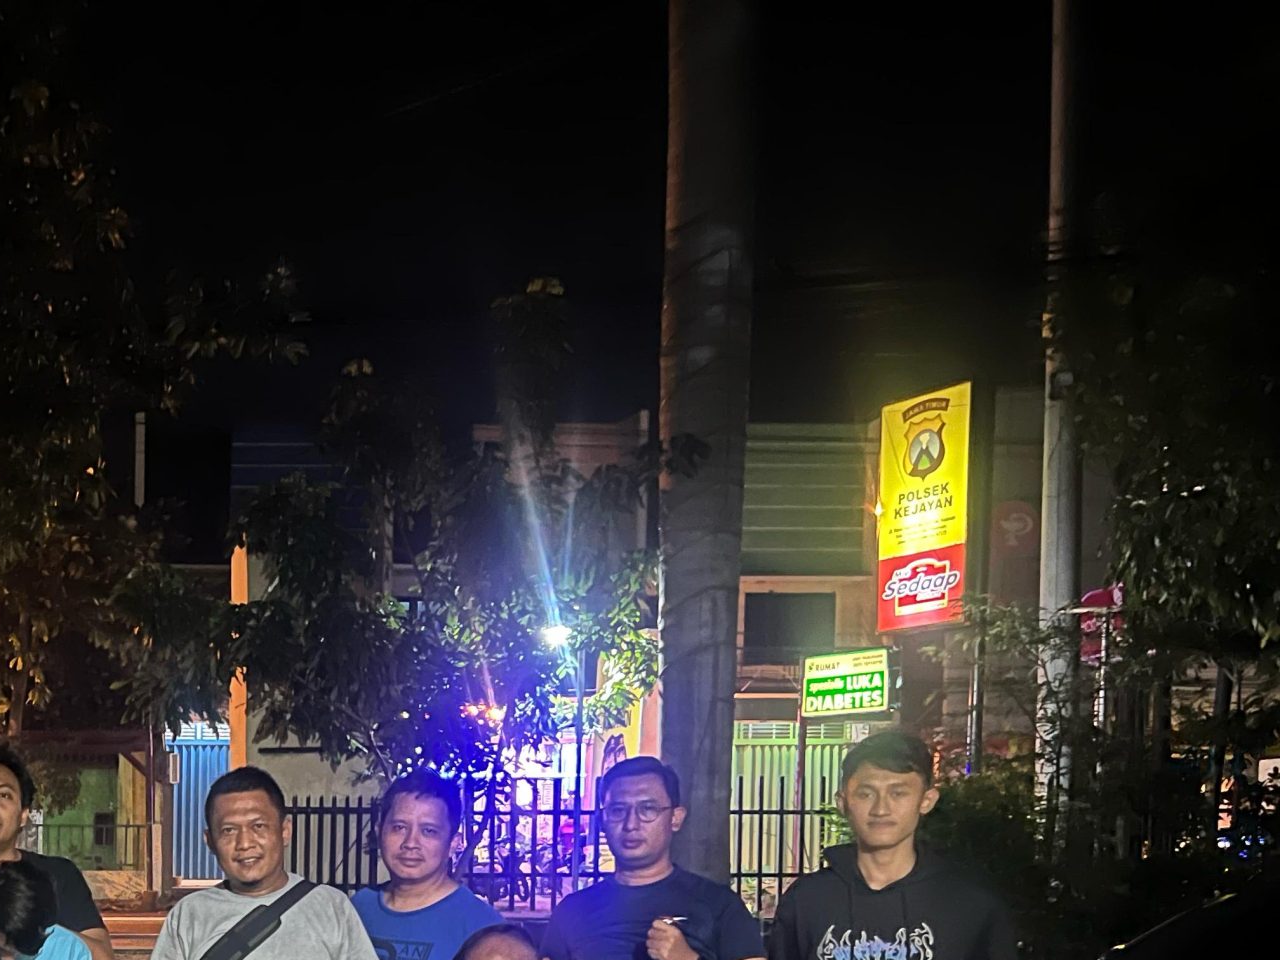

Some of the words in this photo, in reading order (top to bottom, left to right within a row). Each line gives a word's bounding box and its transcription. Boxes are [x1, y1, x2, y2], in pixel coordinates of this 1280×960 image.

[898, 482, 949, 504] POLSEK
[894, 495, 953, 519] KEJAYAN
[884, 573, 958, 598] Sedaap
[846, 672, 882, 690] LUKA
[806, 690, 882, 711] DIABETES
